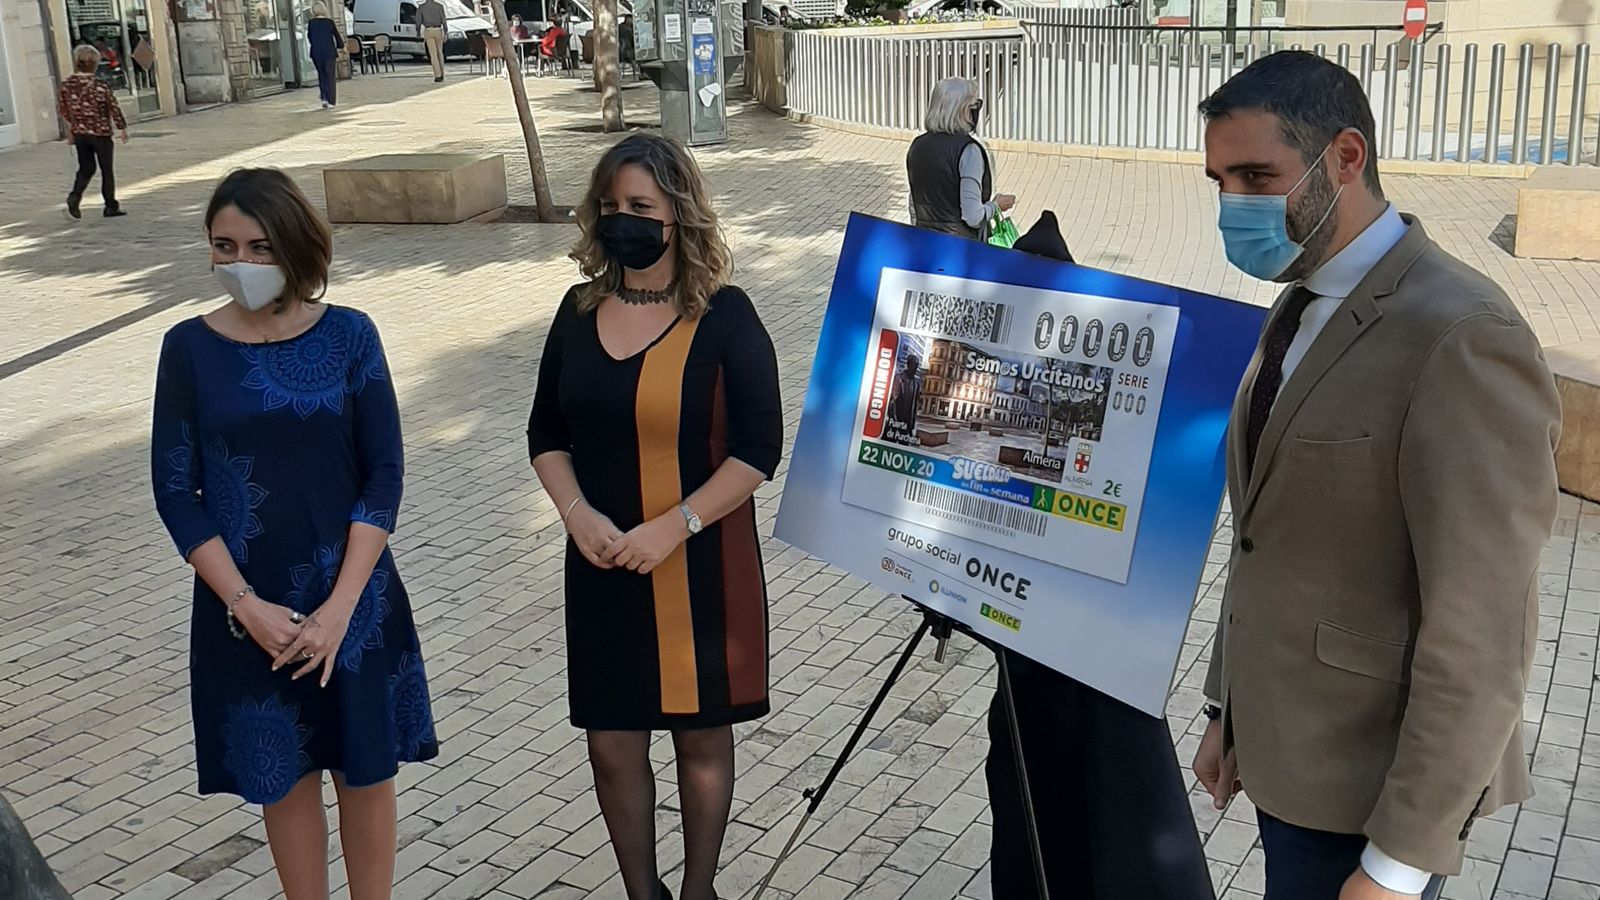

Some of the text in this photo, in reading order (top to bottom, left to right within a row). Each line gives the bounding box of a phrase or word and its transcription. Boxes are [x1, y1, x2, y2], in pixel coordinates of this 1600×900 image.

[1034, 311, 1155, 367] 00000
[870, 347, 893, 420] DOMINGO
[965, 351, 1104, 393] Somos Urcitanos
[1118, 372, 1149, 389] SERIE
[1112, 390, 1147, 416] 000
[889, 417, 908, 430] Puerta
[887, 428, 921, 445] de Purchena
[861, 445, 935, 478] 22 NOV. 20
[970, 480, 983, 492] fin
[990, 486, 1030, 504] semana
[1102, 479, 1123, 498] 2€
[1058, 494, 1121, 526] ONCE
[888, 527, 1032, 600] grupo social ONCE
[894, 568, 912, 580] ONCE
[991, 610, 1019, 629] ONCE
